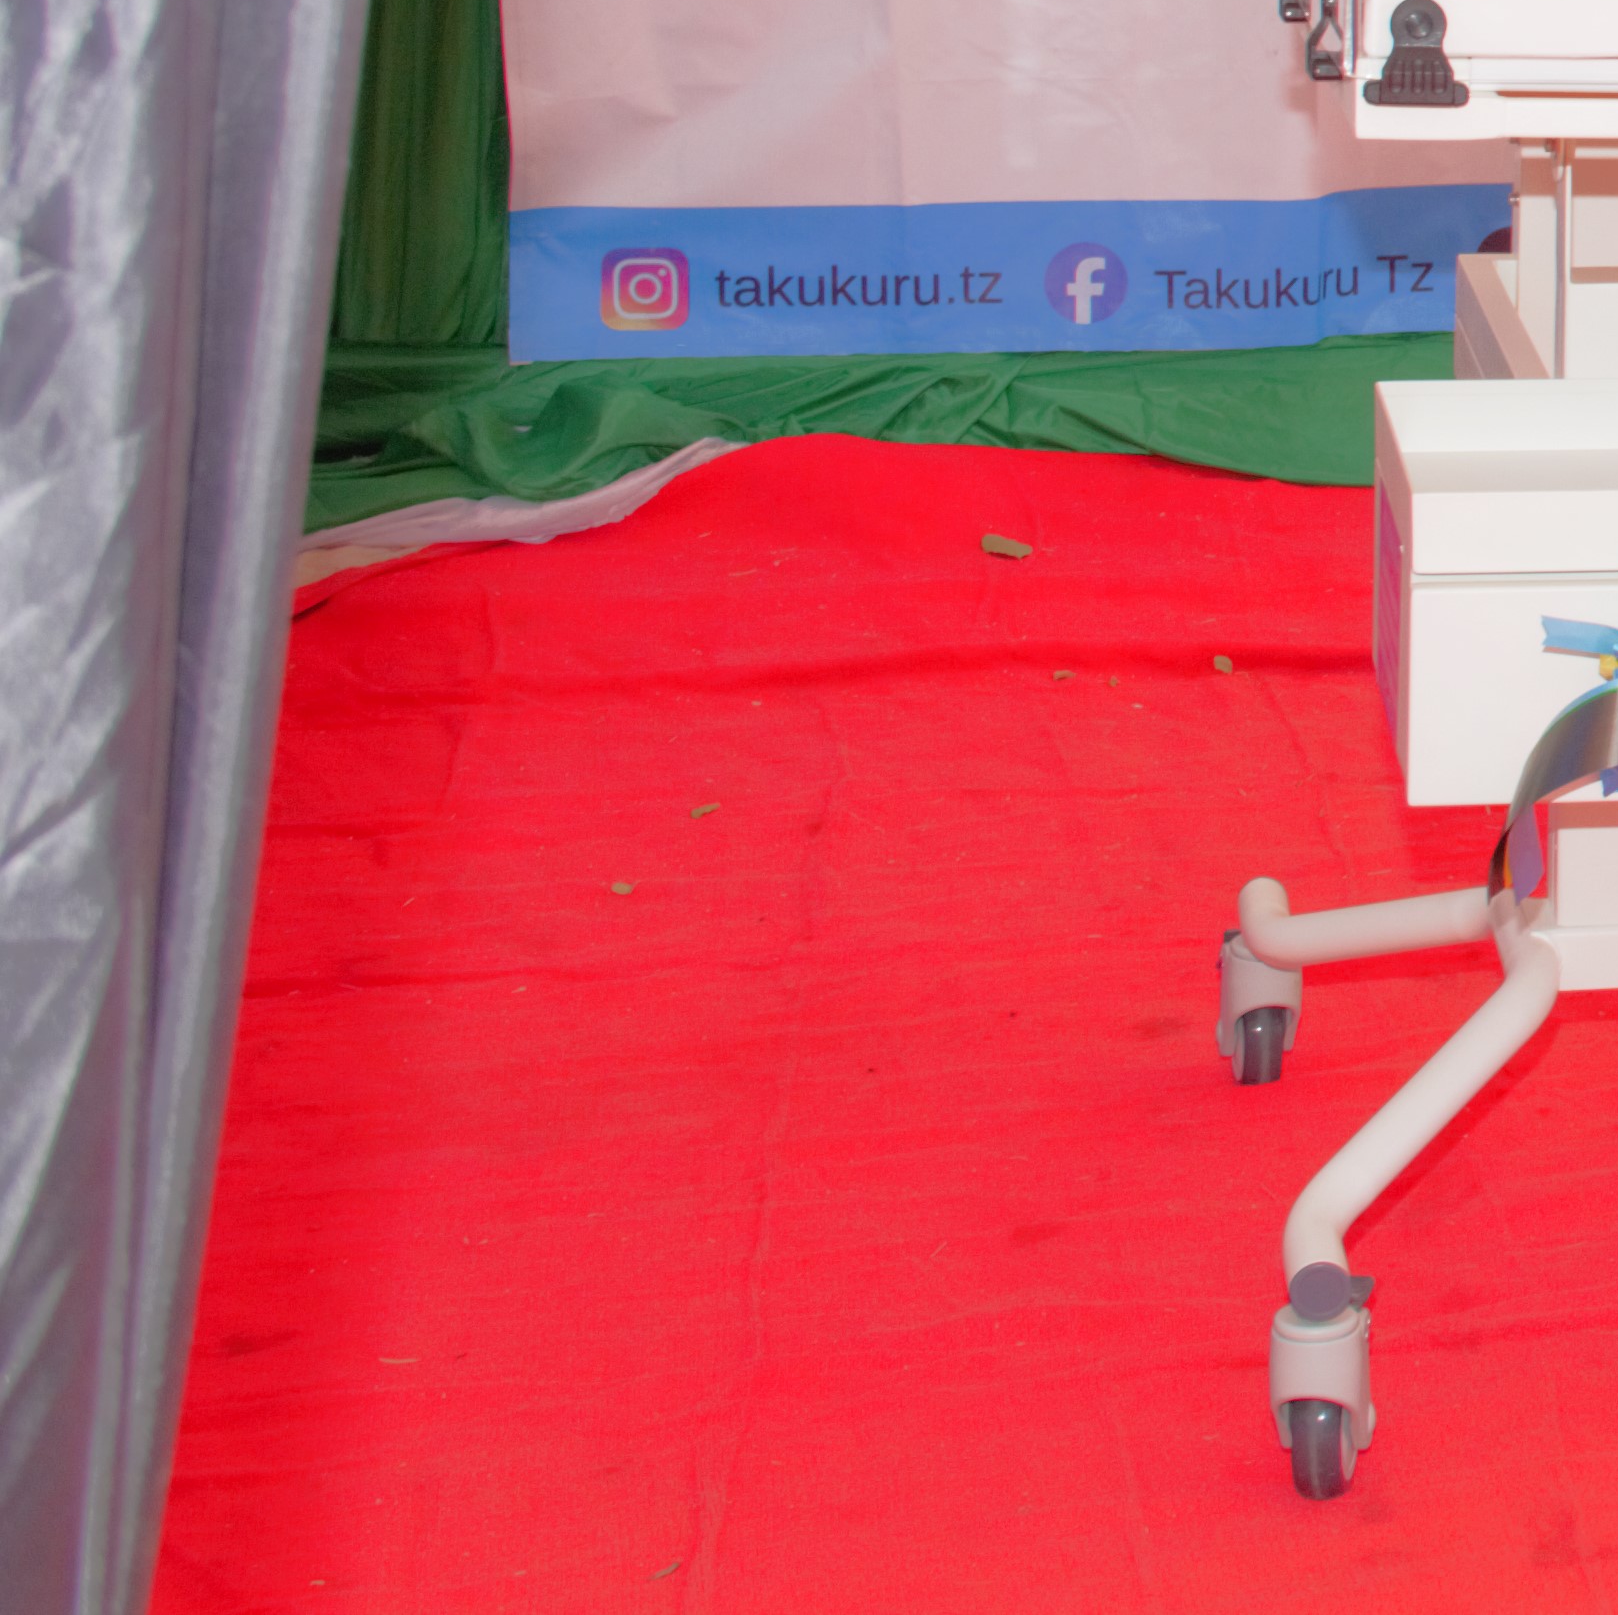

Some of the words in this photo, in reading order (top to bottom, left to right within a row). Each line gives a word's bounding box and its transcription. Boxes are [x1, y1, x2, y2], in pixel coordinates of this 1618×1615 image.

[714, 264, 1003, 308] takukuru.tz
[1154, 256, 1360, 311] Takukuru
[1376, 255, 1435, 296] Tz
